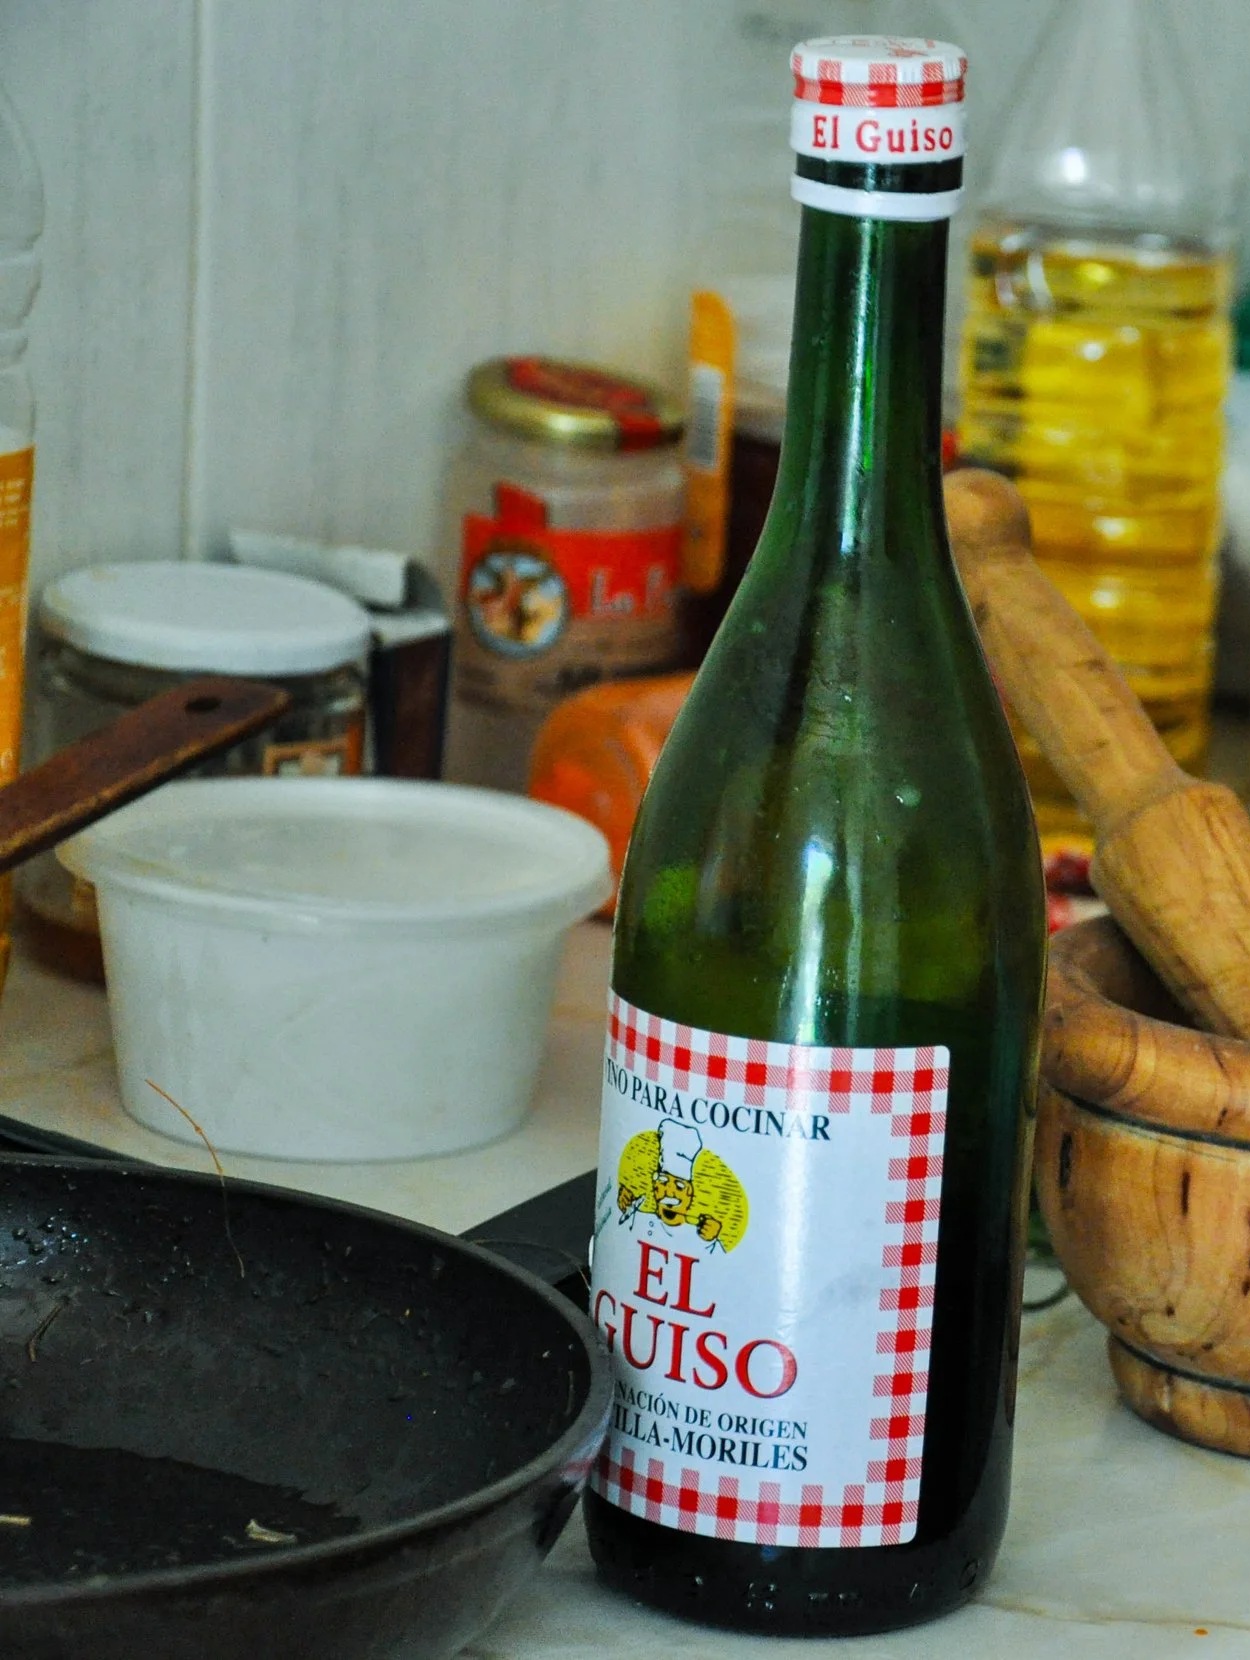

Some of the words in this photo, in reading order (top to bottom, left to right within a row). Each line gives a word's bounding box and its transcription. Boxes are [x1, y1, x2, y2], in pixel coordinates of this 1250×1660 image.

[812, 115, 840, 149] El
[855, 119, 953, 153] Guiso
[632, 1076, 684, 1119] PARA
[691, 1098, 831, 1141] COCINAR
[633, 1239, 716, 1318] EL
[594, 1289, 797, 1399] GUISO
[613, 1402, 808, 1471] ILLA-MORILES
[685, 1405, 711, 1429] DE
[718, 1413, 807, 1440] ORIGEN
